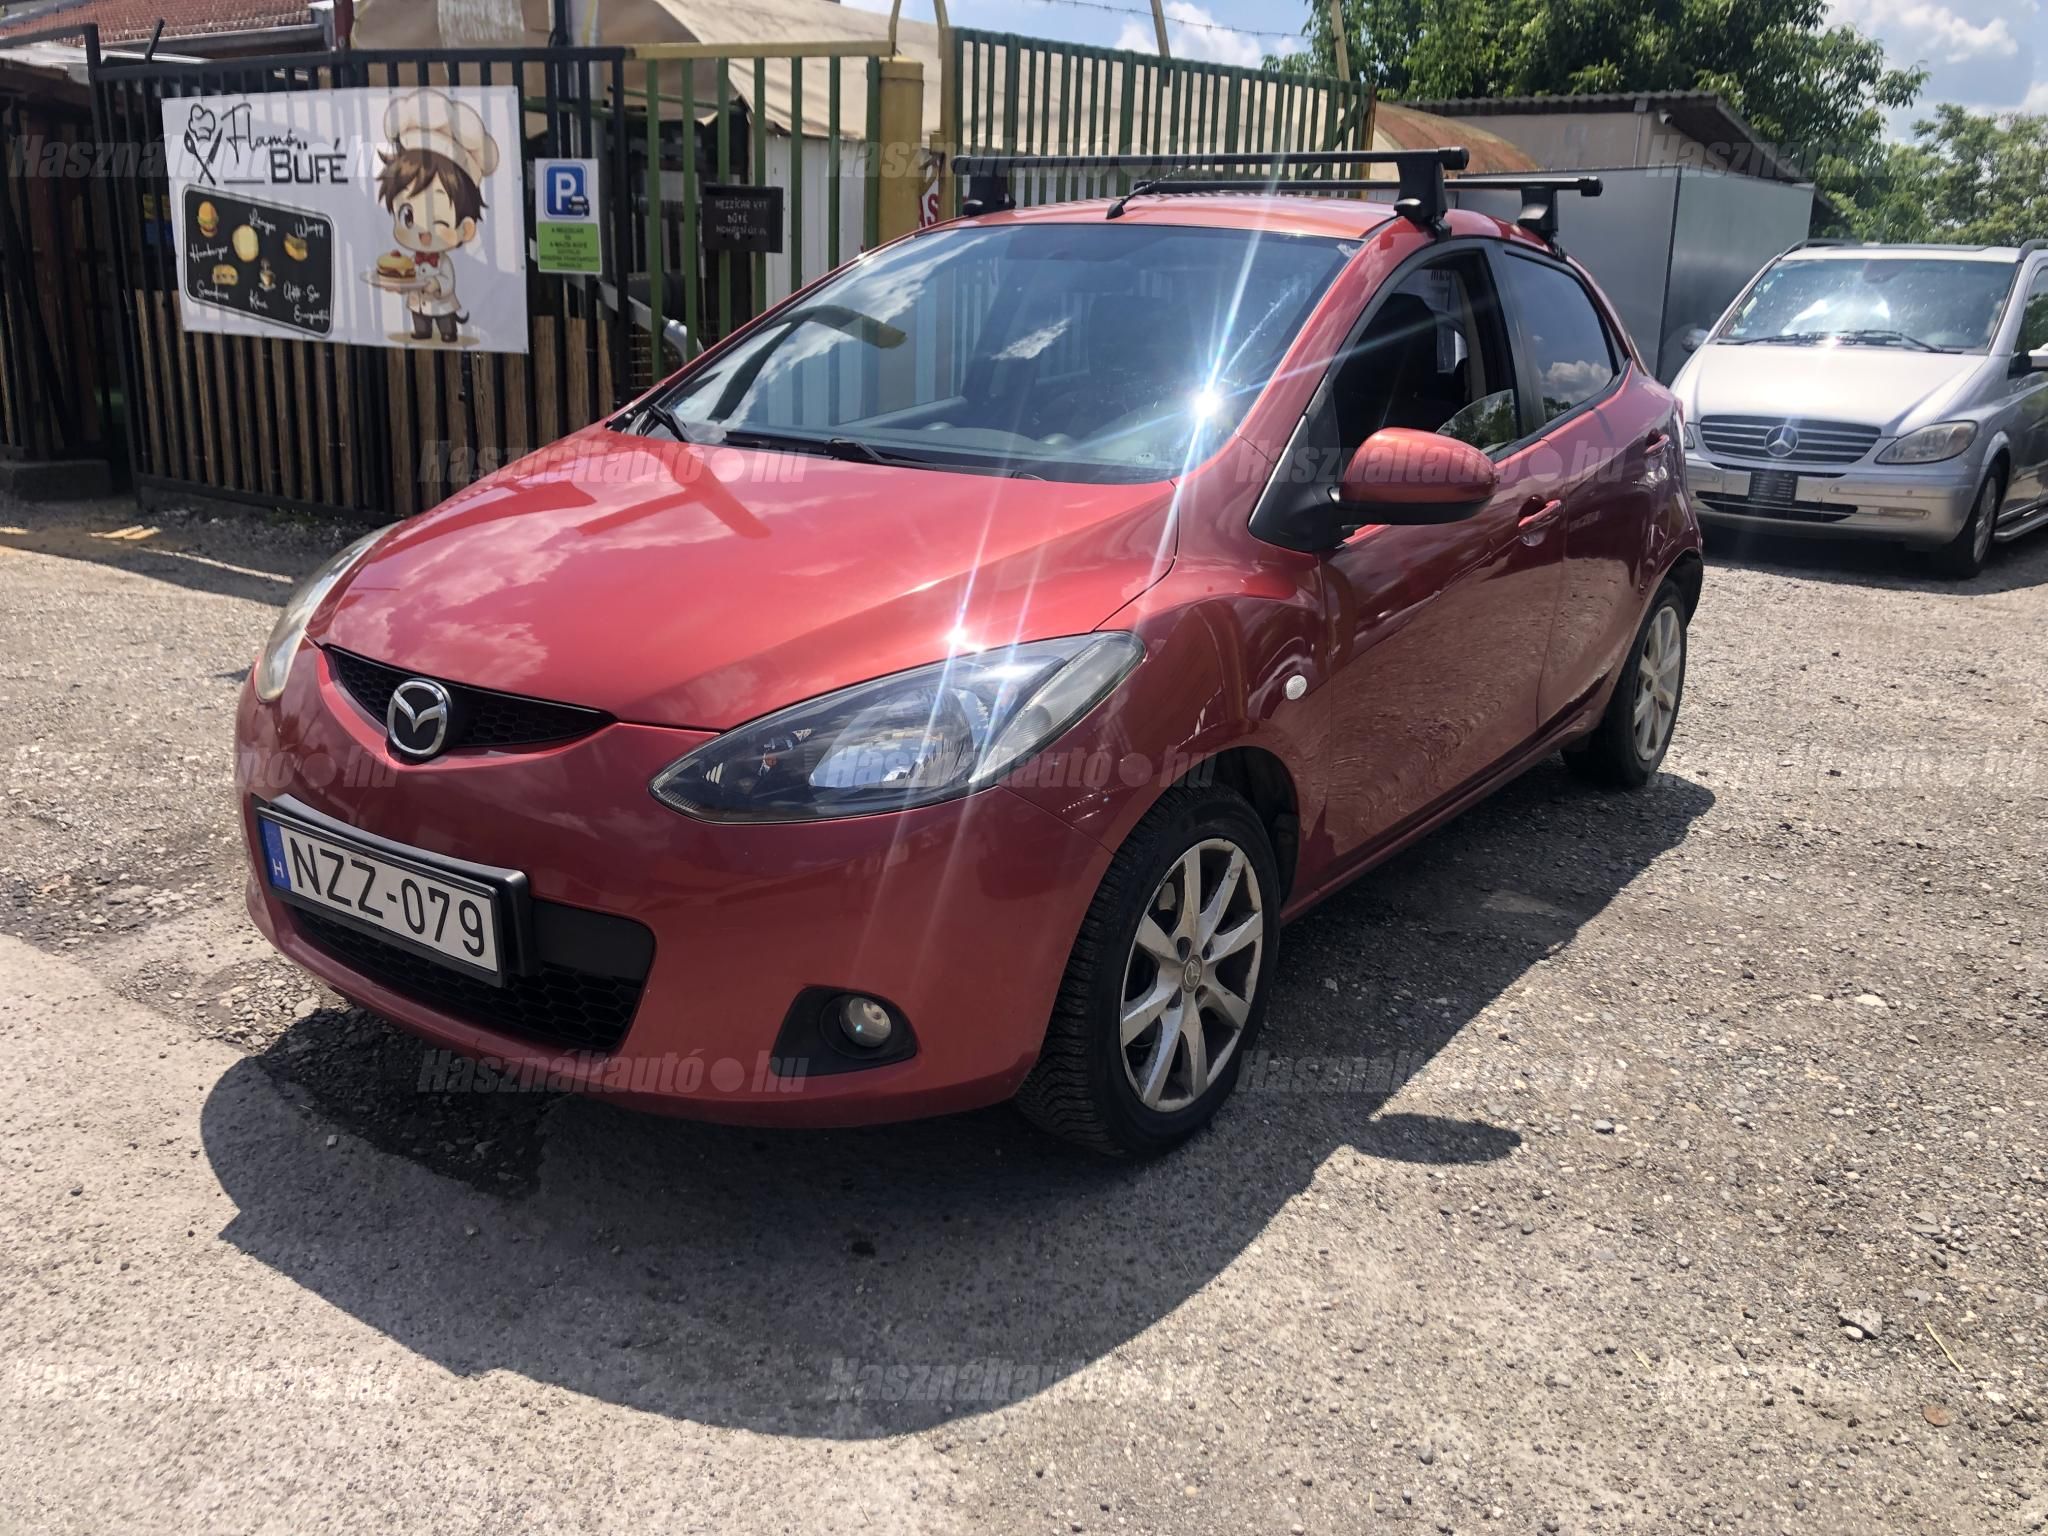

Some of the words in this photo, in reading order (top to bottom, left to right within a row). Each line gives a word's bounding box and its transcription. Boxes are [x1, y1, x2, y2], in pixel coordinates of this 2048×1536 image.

[270, 138, 349, 185] BÜFÉ
[555, 172, 577, 211] P
[272, 858, 285, 879] H
[289, 837, 485, 958] NZZ-079
